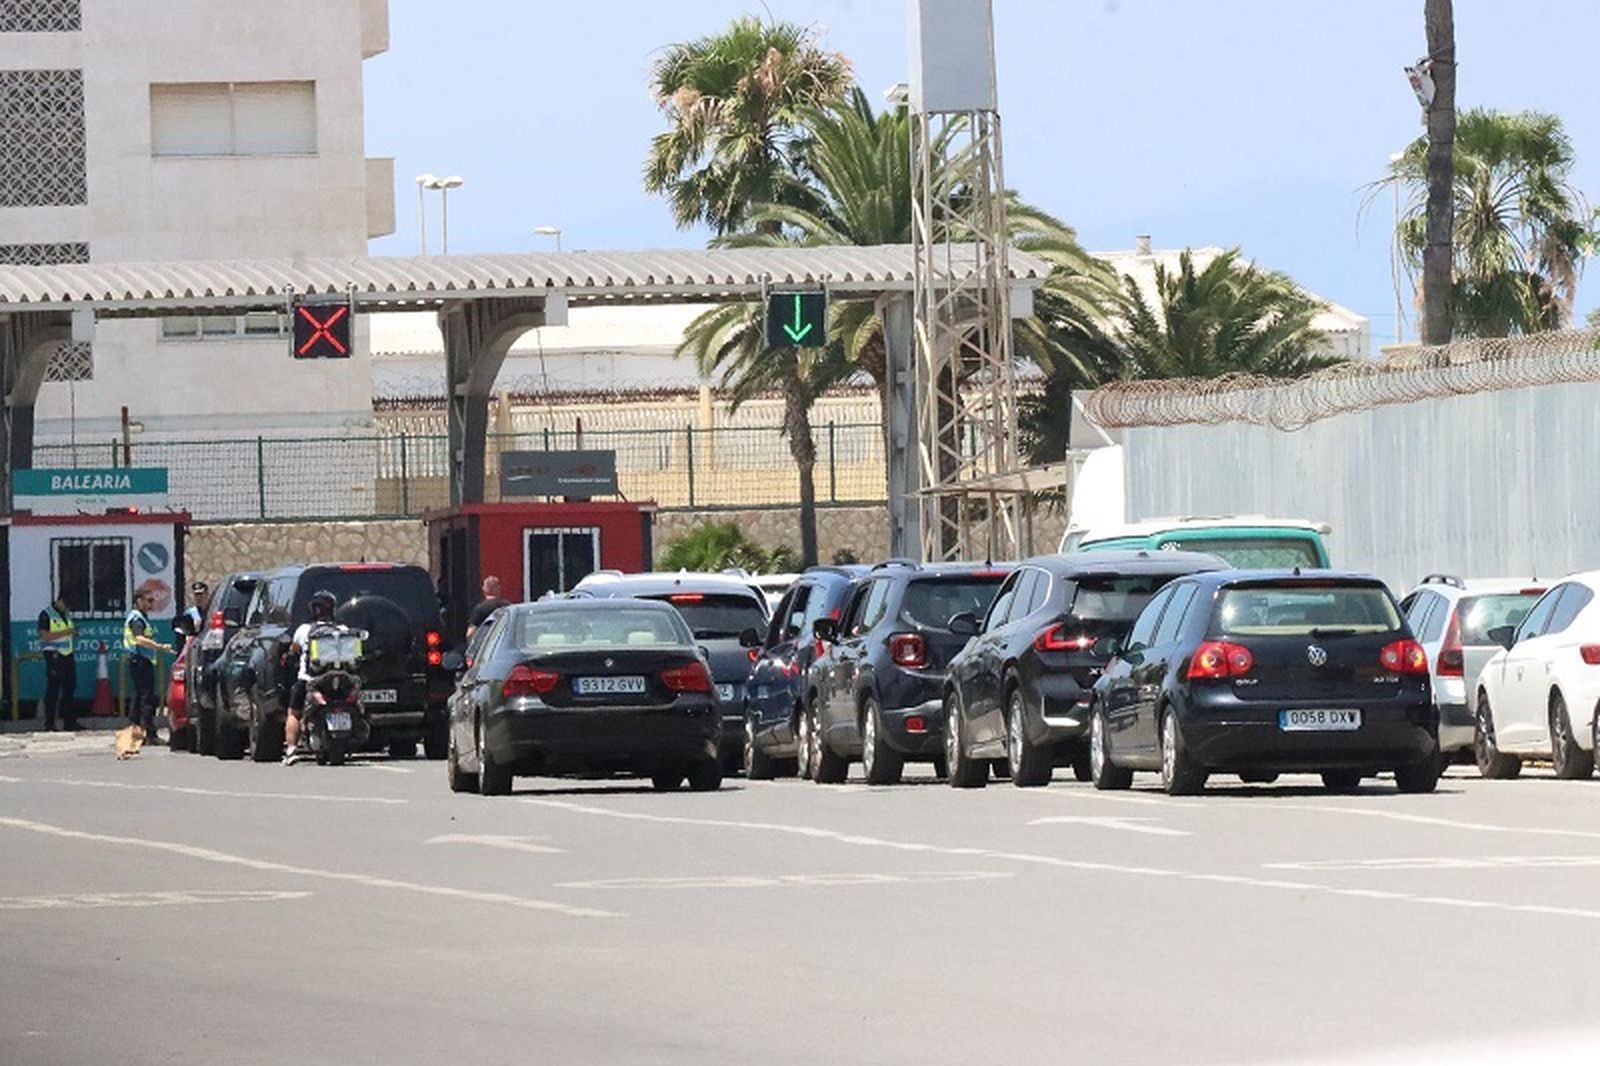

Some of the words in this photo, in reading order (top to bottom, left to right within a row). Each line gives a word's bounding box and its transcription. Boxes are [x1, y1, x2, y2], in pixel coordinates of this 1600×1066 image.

[51, 474, 132, 491] BALEARIA
[582, 679, 615, 691] 9312
[618, 677, 643, 690] GVV
[1291, 711, 1325, 725] 0058
